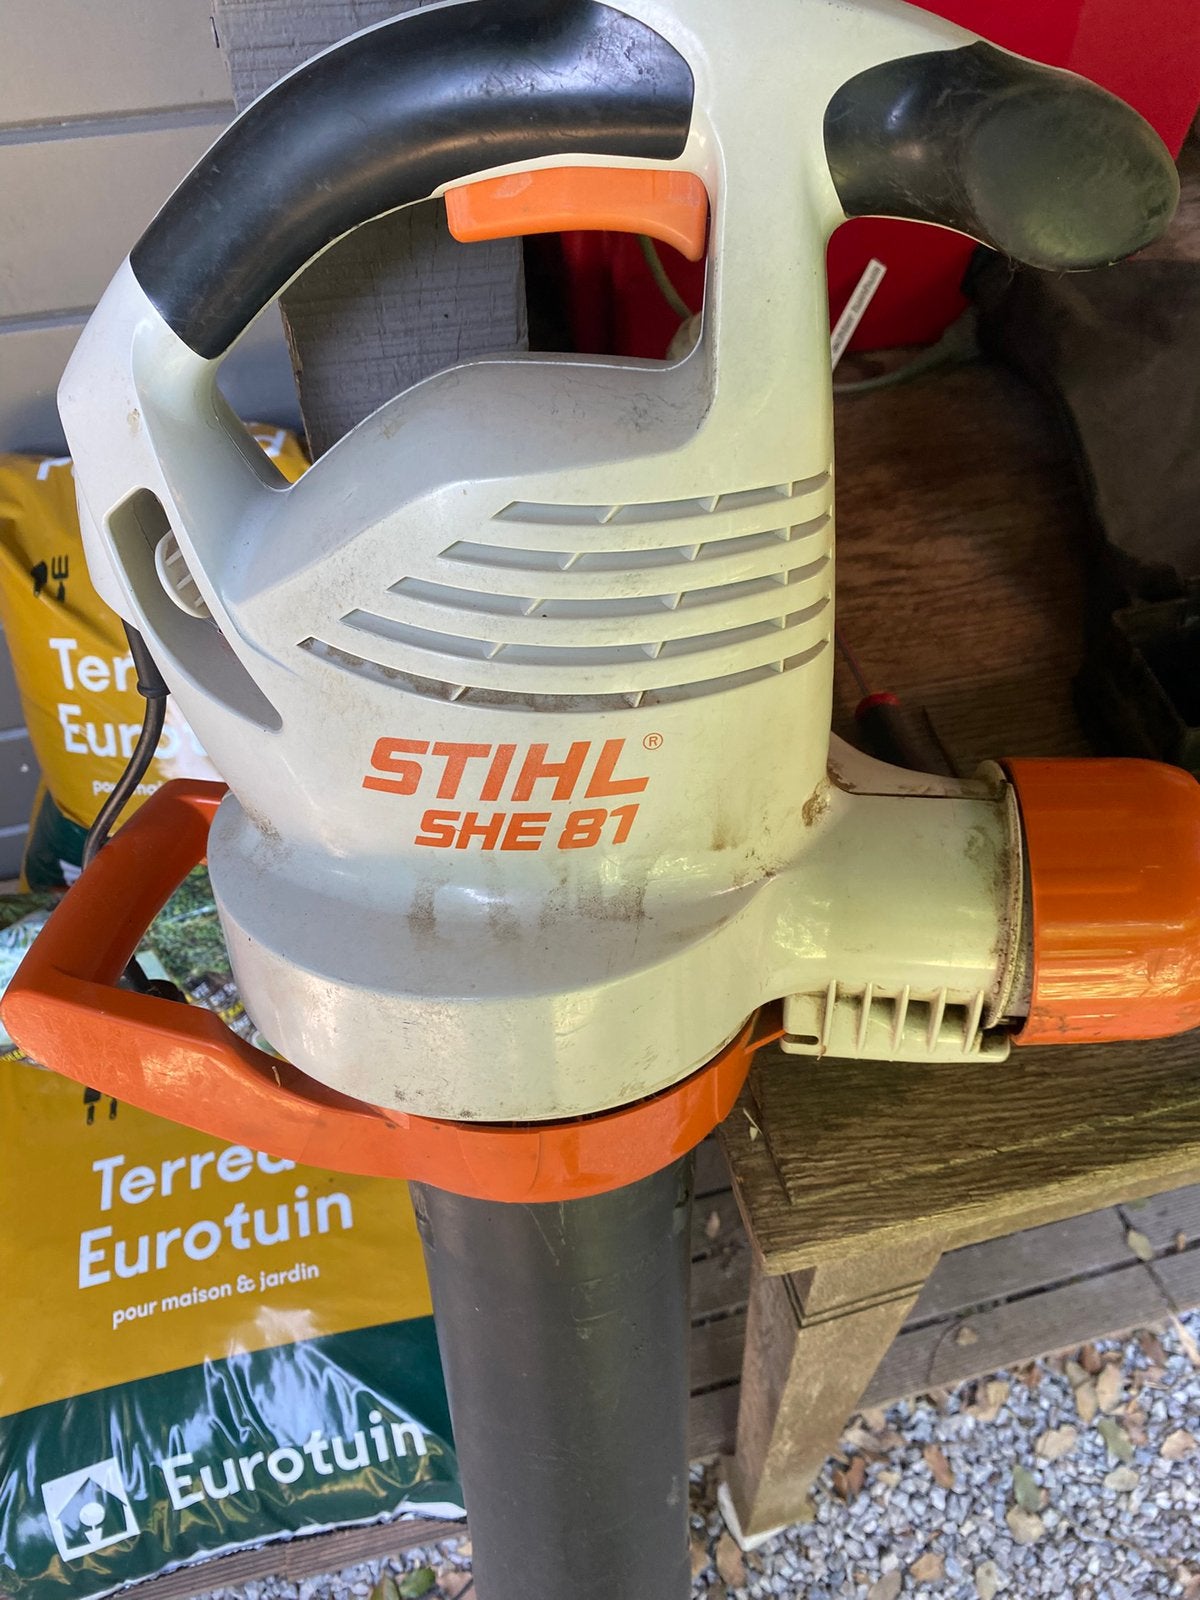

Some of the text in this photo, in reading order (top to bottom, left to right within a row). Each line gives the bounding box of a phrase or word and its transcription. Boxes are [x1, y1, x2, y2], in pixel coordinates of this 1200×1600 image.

[48, 638, 135, 692] Ter
[361, 736, 650, 802] STIHL
[414, 803, 640, 851] SHE 81
[78, 1184, 354, 1289] Eurotuin
[112, 1263, 320, 1330] pour maison & jardin
[162, 1409, 429, 1511] Eurotuin
